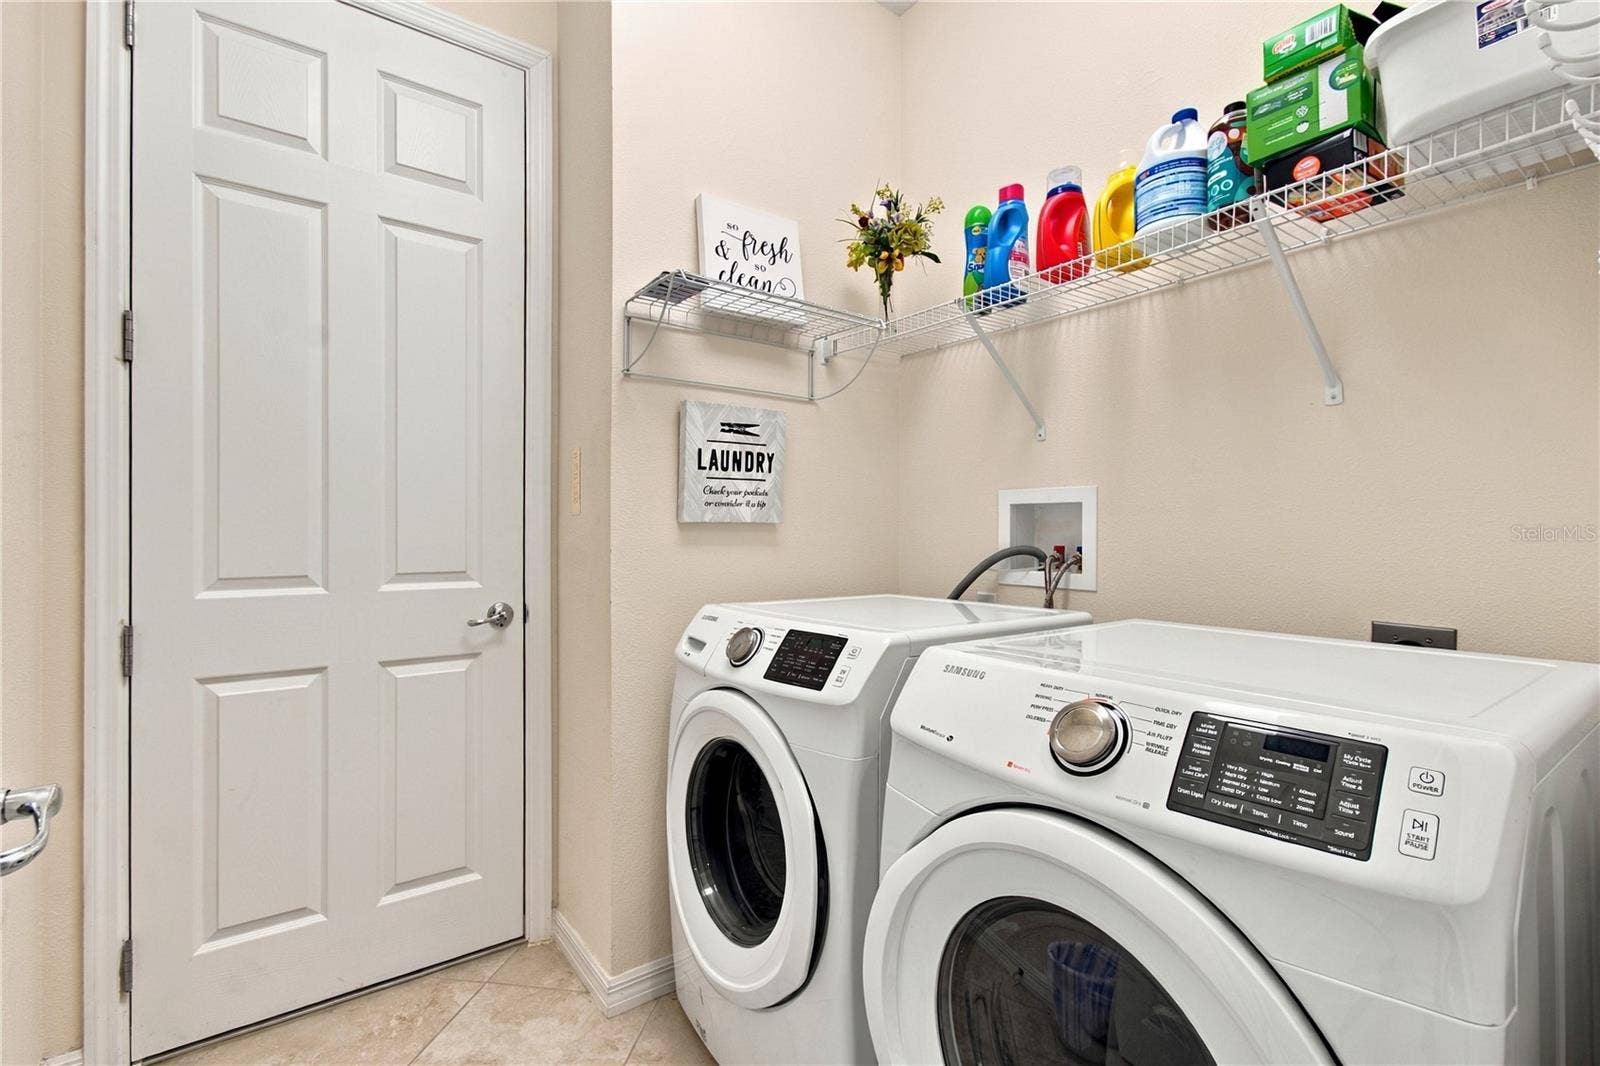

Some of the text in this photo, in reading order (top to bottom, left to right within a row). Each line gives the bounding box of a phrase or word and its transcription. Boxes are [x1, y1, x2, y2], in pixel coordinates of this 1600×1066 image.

[715, 230, 794, 266] & fresh
[718, 261, 784, 295] clean
[697, 447, 775, 474] LAUNDRY
[702, 484, 769, 499] Check your pockets
[714, 499, 743, 508] consider
[757, 500, 767, 510] tip
[943, 663, 987, 681] SAMSUNG
[1154, 706, 1170, 714] QUICK
[1156, 733, 1174, 741] FLUFF
[1145, 740, 1170, 750] WRINKLE
[1144, 746, 1169, 756] RELEASE
[1342, 752, 1372, 763] My Cycle
[1226, 763, 1248, 773] Very Dry
[1222, 777, 1251, 789] Normal Dry
[1259, 778, 1281, 788] Medium
[1341, 775, 1363, 784] Adjust
[1235, 788, 1246, 796] Dry
[1412, 782, 1440, 793] POWER
[1210, 797, 1238, 809] Dry Level
[1255, 794, 1271, 802] Extra
[1338, 799, 1360, 809] Adjust
[1292, 819, 1309, 828] Time
[1333, 828, 1356, 838] Sound
[1406, 832, 1431, 843] START
[1404, 840, 1430, 852] PAUSE
